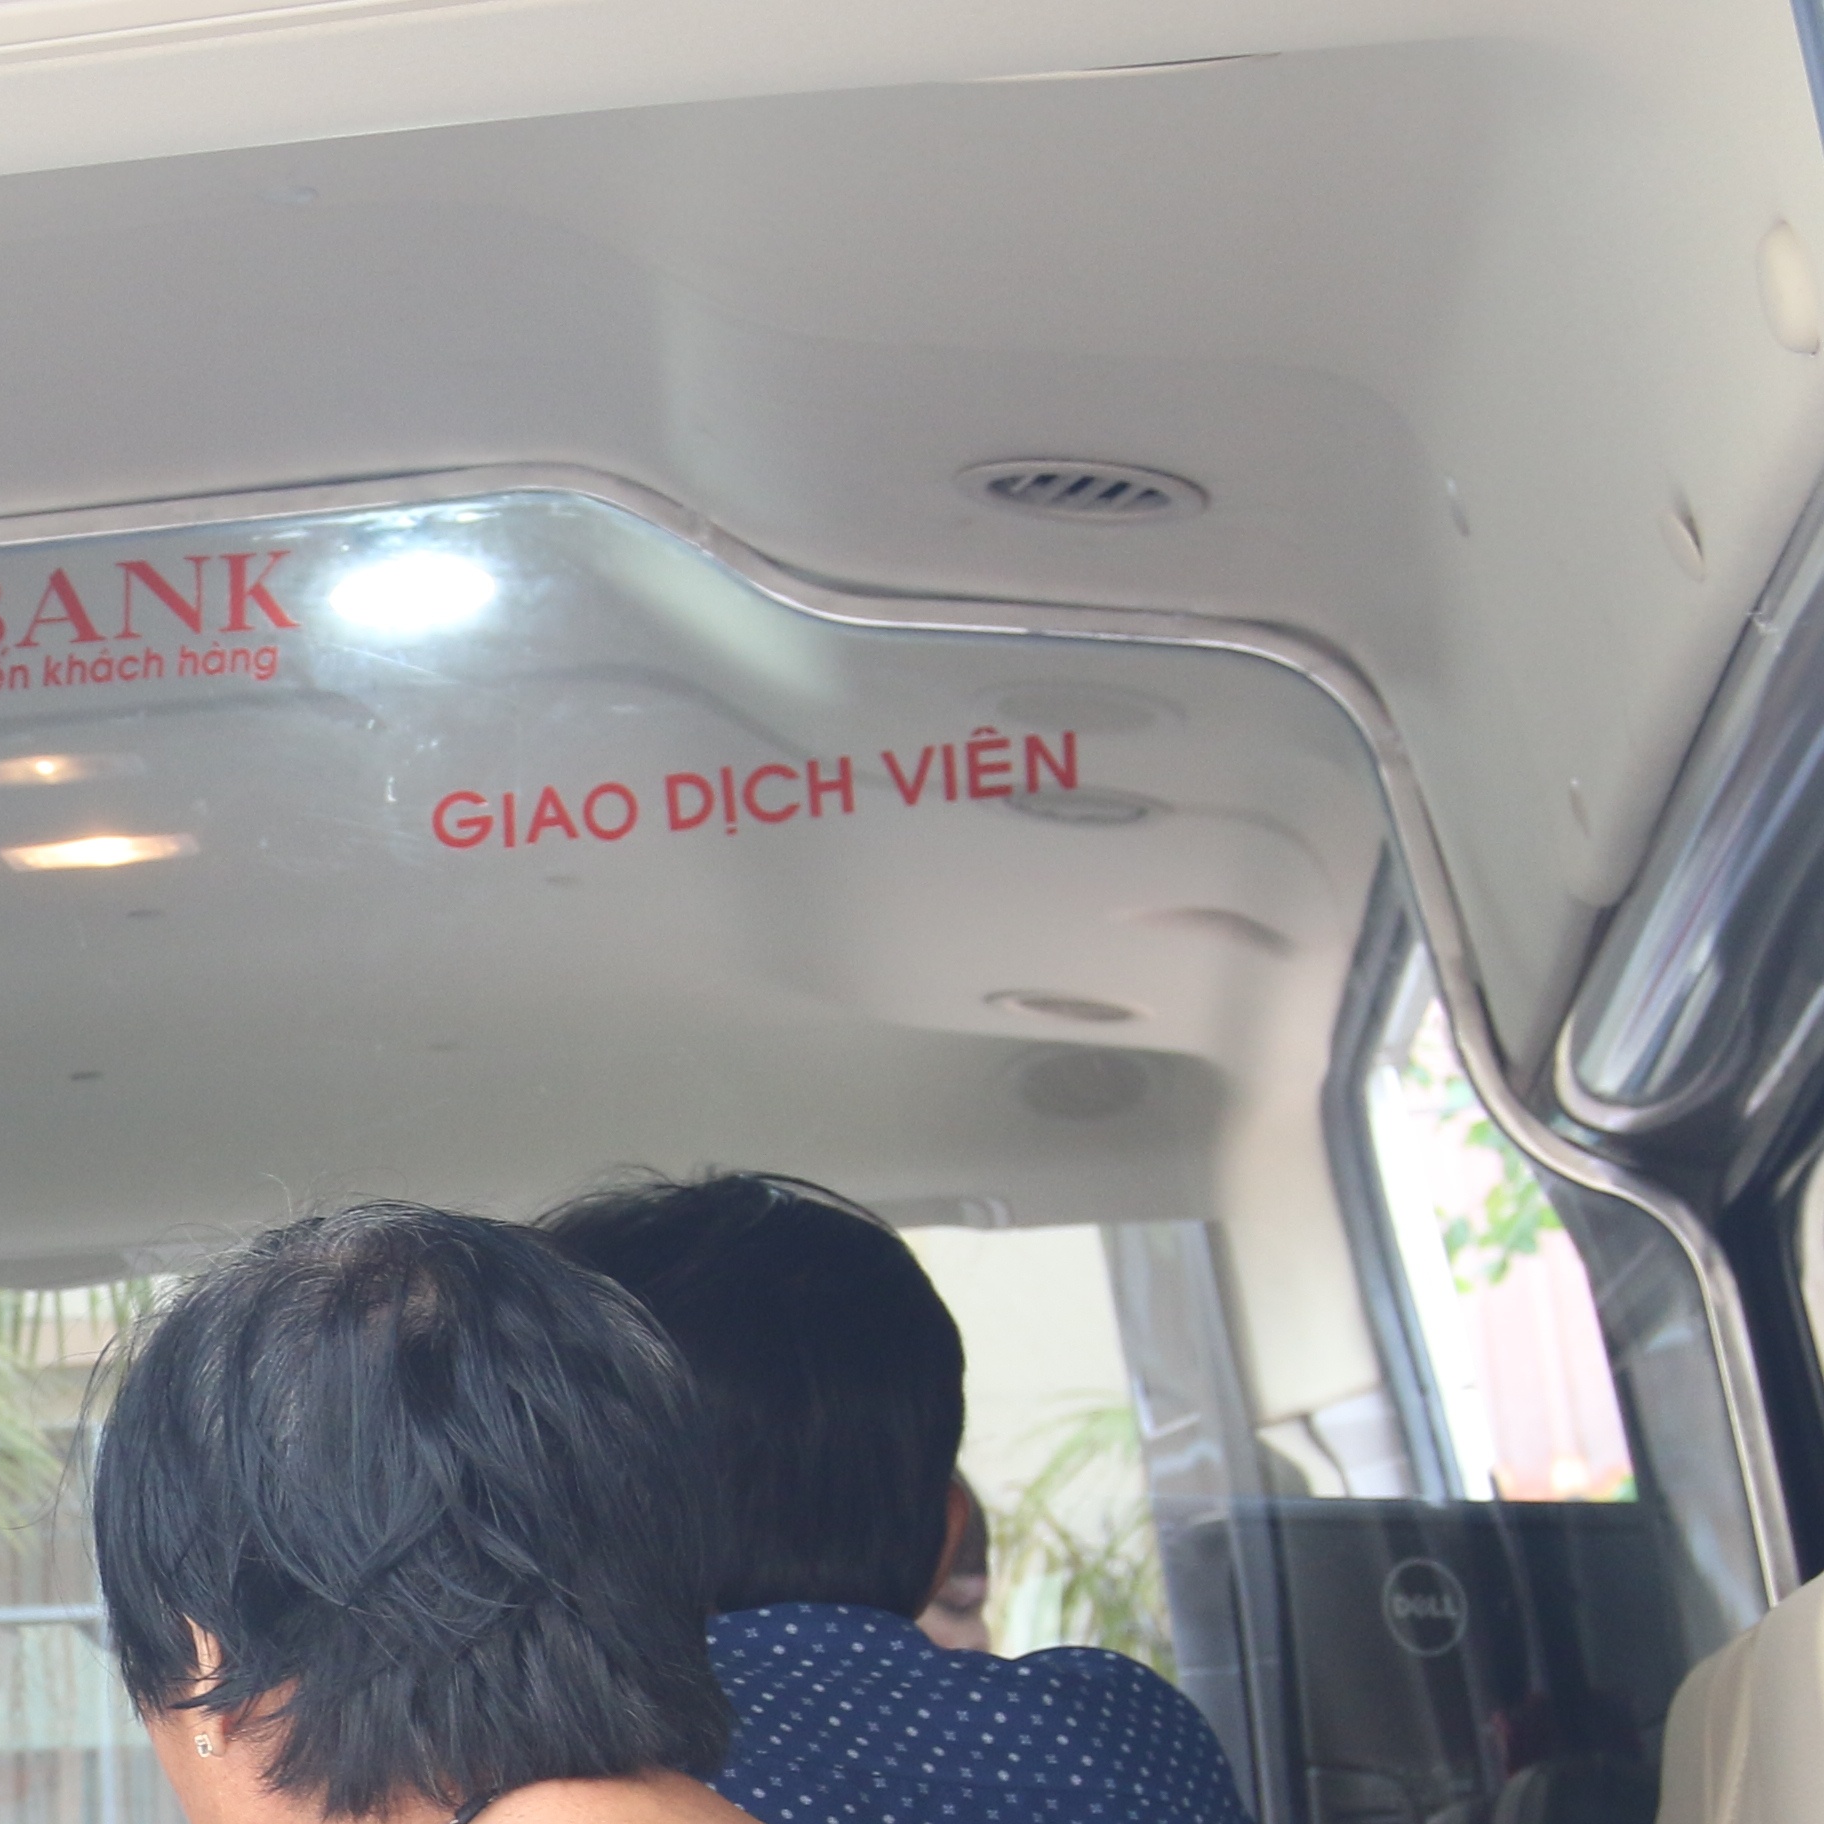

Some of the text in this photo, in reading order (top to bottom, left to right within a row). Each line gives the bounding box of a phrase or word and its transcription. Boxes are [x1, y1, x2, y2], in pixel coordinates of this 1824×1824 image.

[43, 648, 165, 686] khách
[177, 640, 279, 682] hàng
[431, 725, 1079, 850] GIAO DỊCH VIÊN
